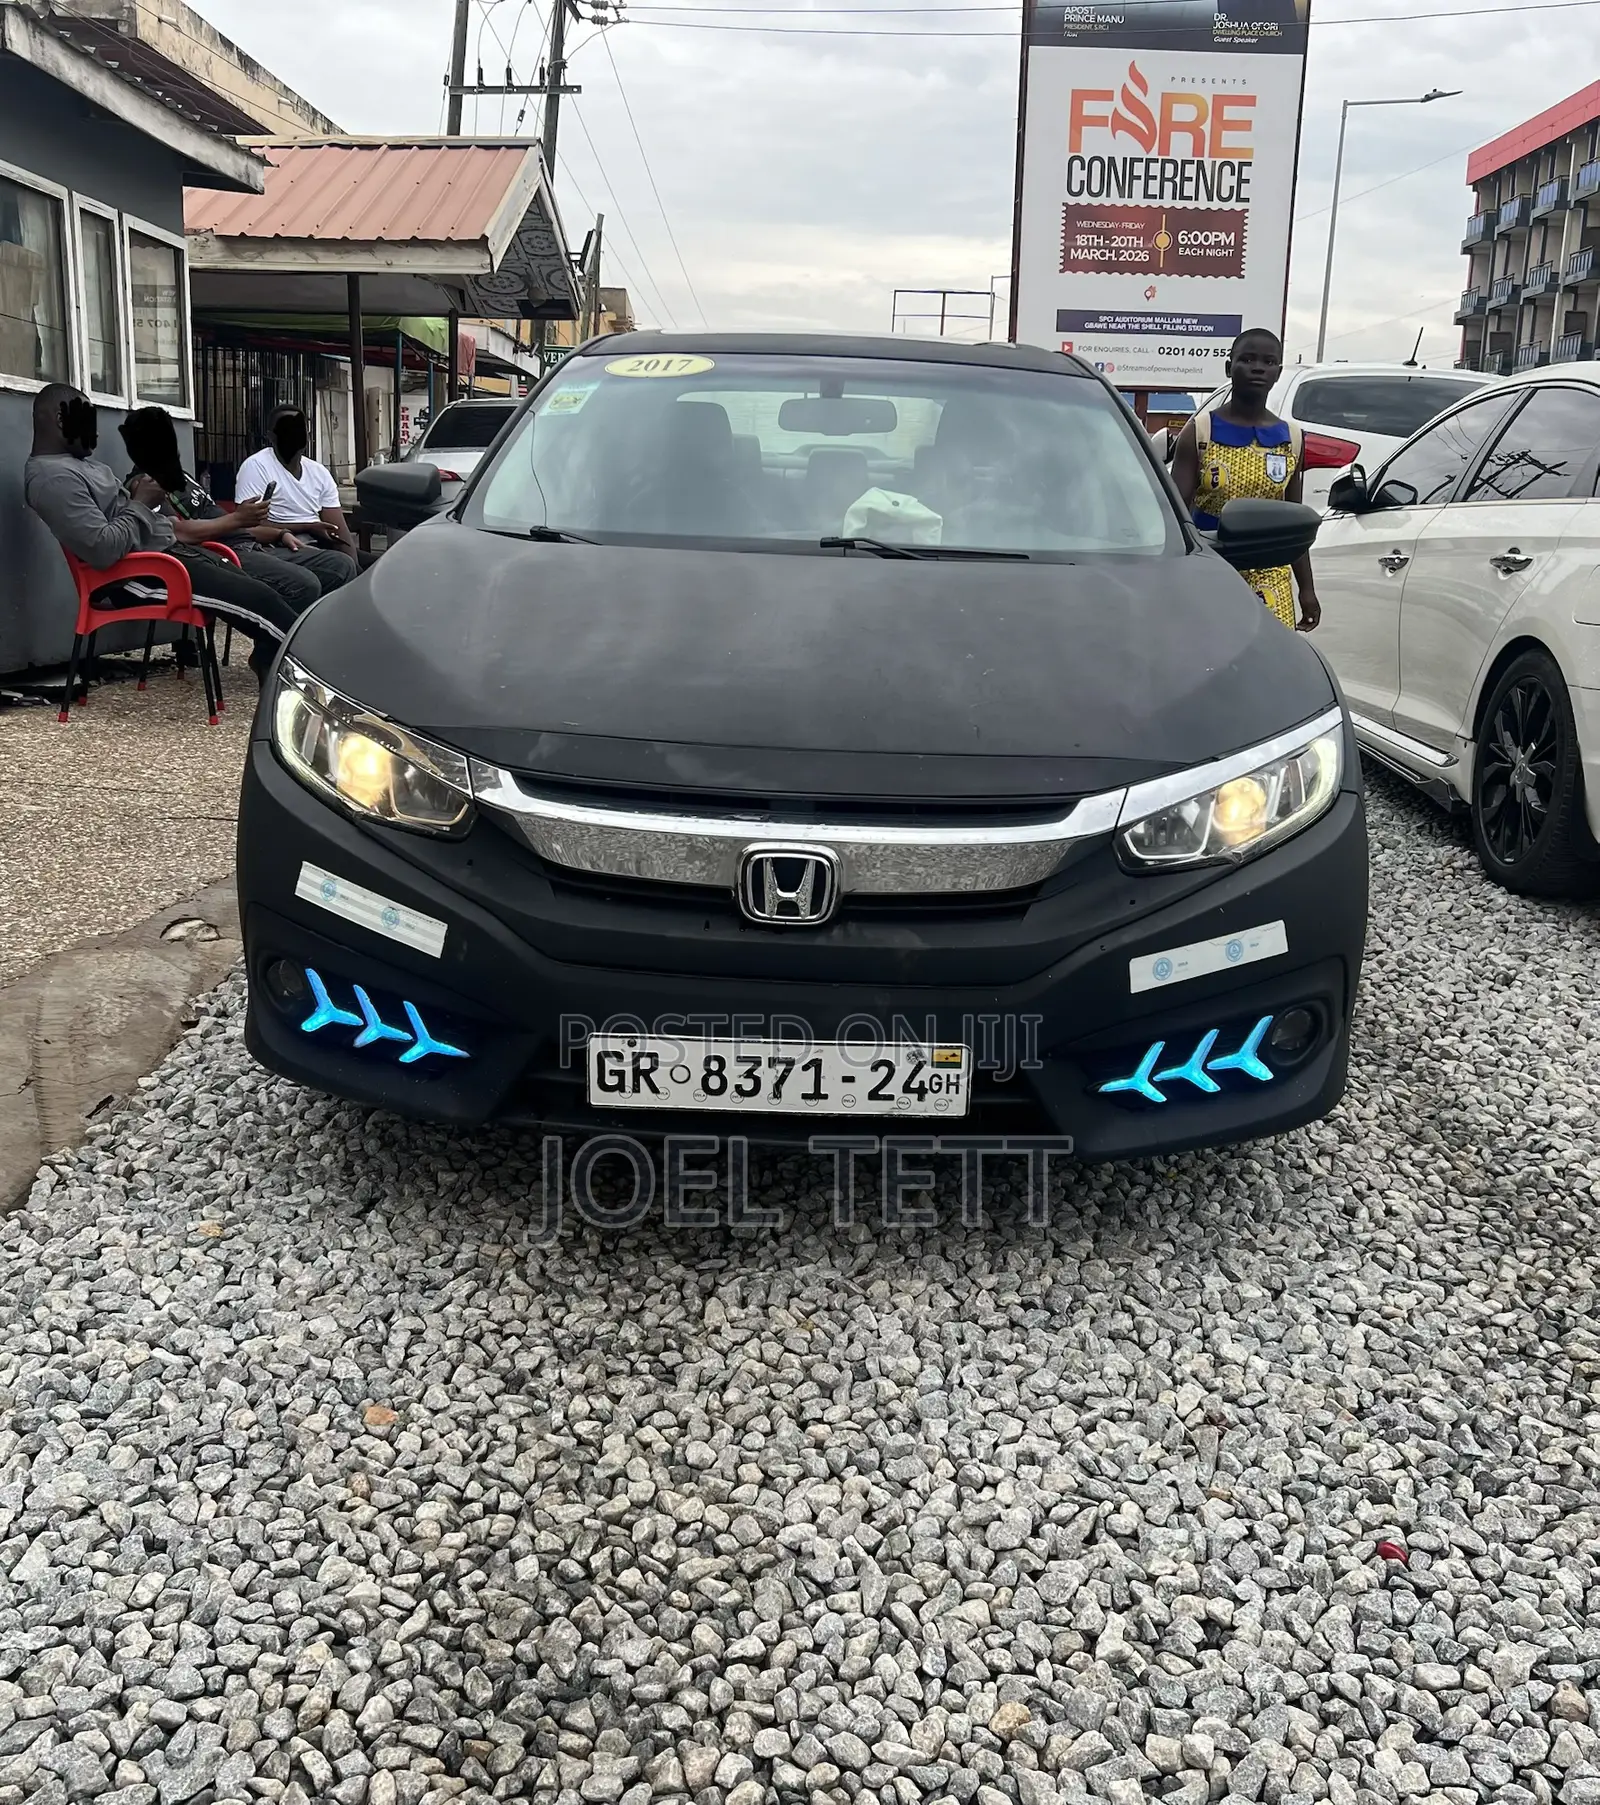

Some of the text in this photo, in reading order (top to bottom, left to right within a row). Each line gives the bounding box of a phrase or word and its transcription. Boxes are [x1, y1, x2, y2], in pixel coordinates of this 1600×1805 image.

[1064, 6, 1096, 15] APOST.
[1064, 14, 1125, 24] PRINCE MANU
[1213, 12, 1228, 21] DR.
[1170, 76, 1247, 86] PRESENTS
[1066, 154, 1253, 204] CONFERENCE
[1178, 230, 1235, 246] 6:00PM
[1119, 249, 1150, 262] 2026
[1178, 247, 1235, 257] EACH NIGHT
[1098, 315, 1114, 323] SPCI
[1114, 316, 1154, 324] AUDITORIUM
[1162, 324, 1187, 332] FILLING
[1157, 346, 1186, 357] 0201
[1188, 347, 1210, 358] 407
[626, 359, 693, 373] 2017
[596, 1050, 661, 1095] GR
[929, 1073, 960, 1095] GH
